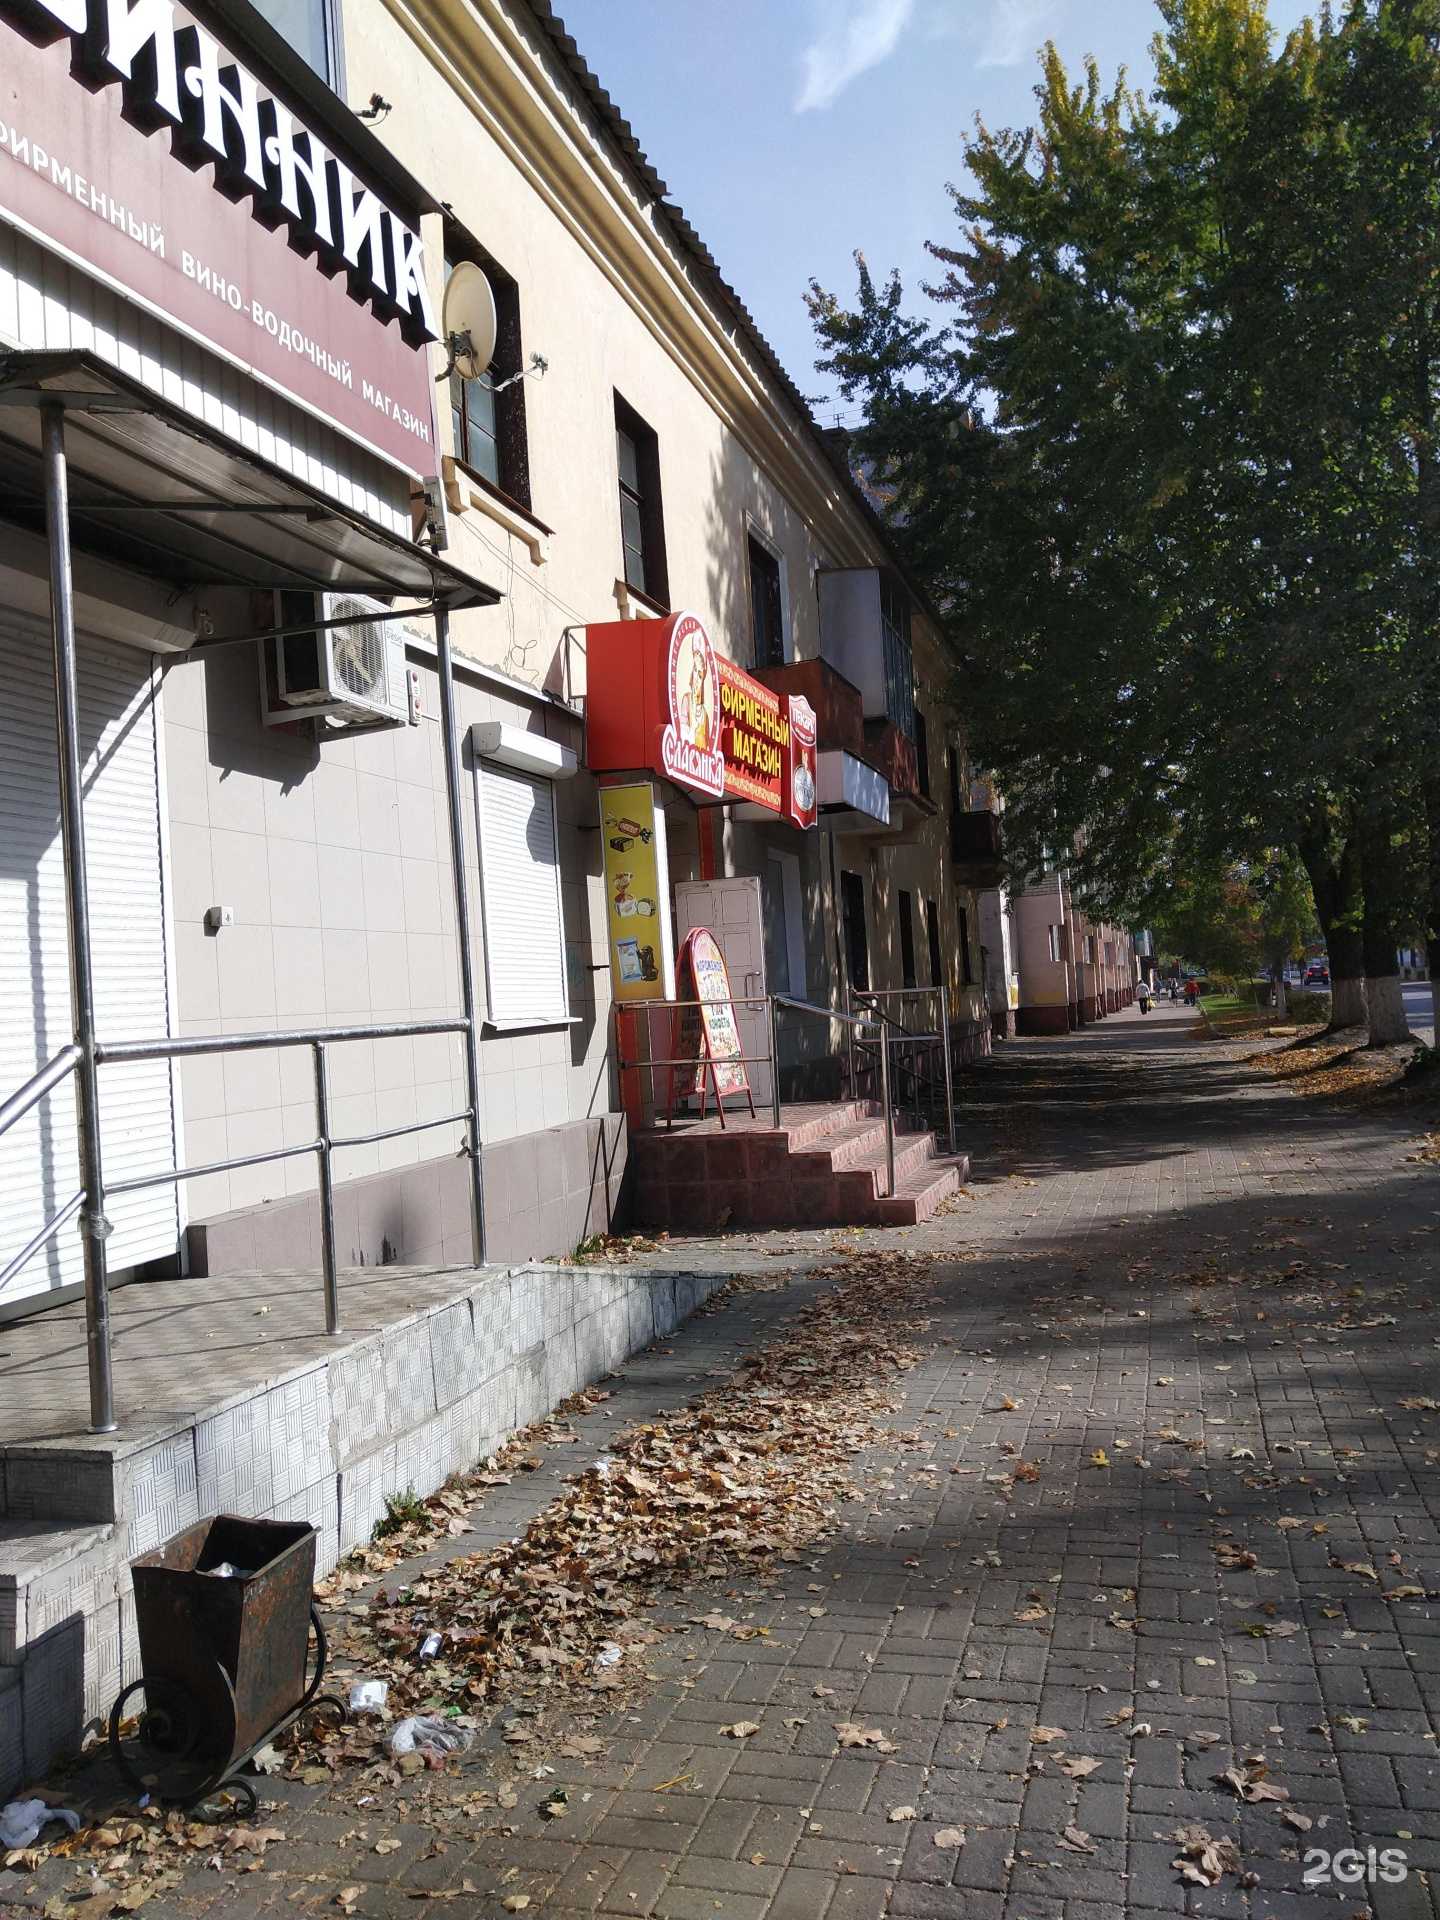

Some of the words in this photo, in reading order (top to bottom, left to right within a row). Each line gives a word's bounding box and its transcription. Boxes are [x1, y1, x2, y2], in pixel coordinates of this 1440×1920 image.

[182, 250, 353, 390] ВИНО-ВОДОЧНЫЙ
[362, 379, 429, 443] МАГАЗИН
[721, 684, 790, 748] ФИРМЕННЫЙ
[733, 727, 781, 779] МАГАЗИН
